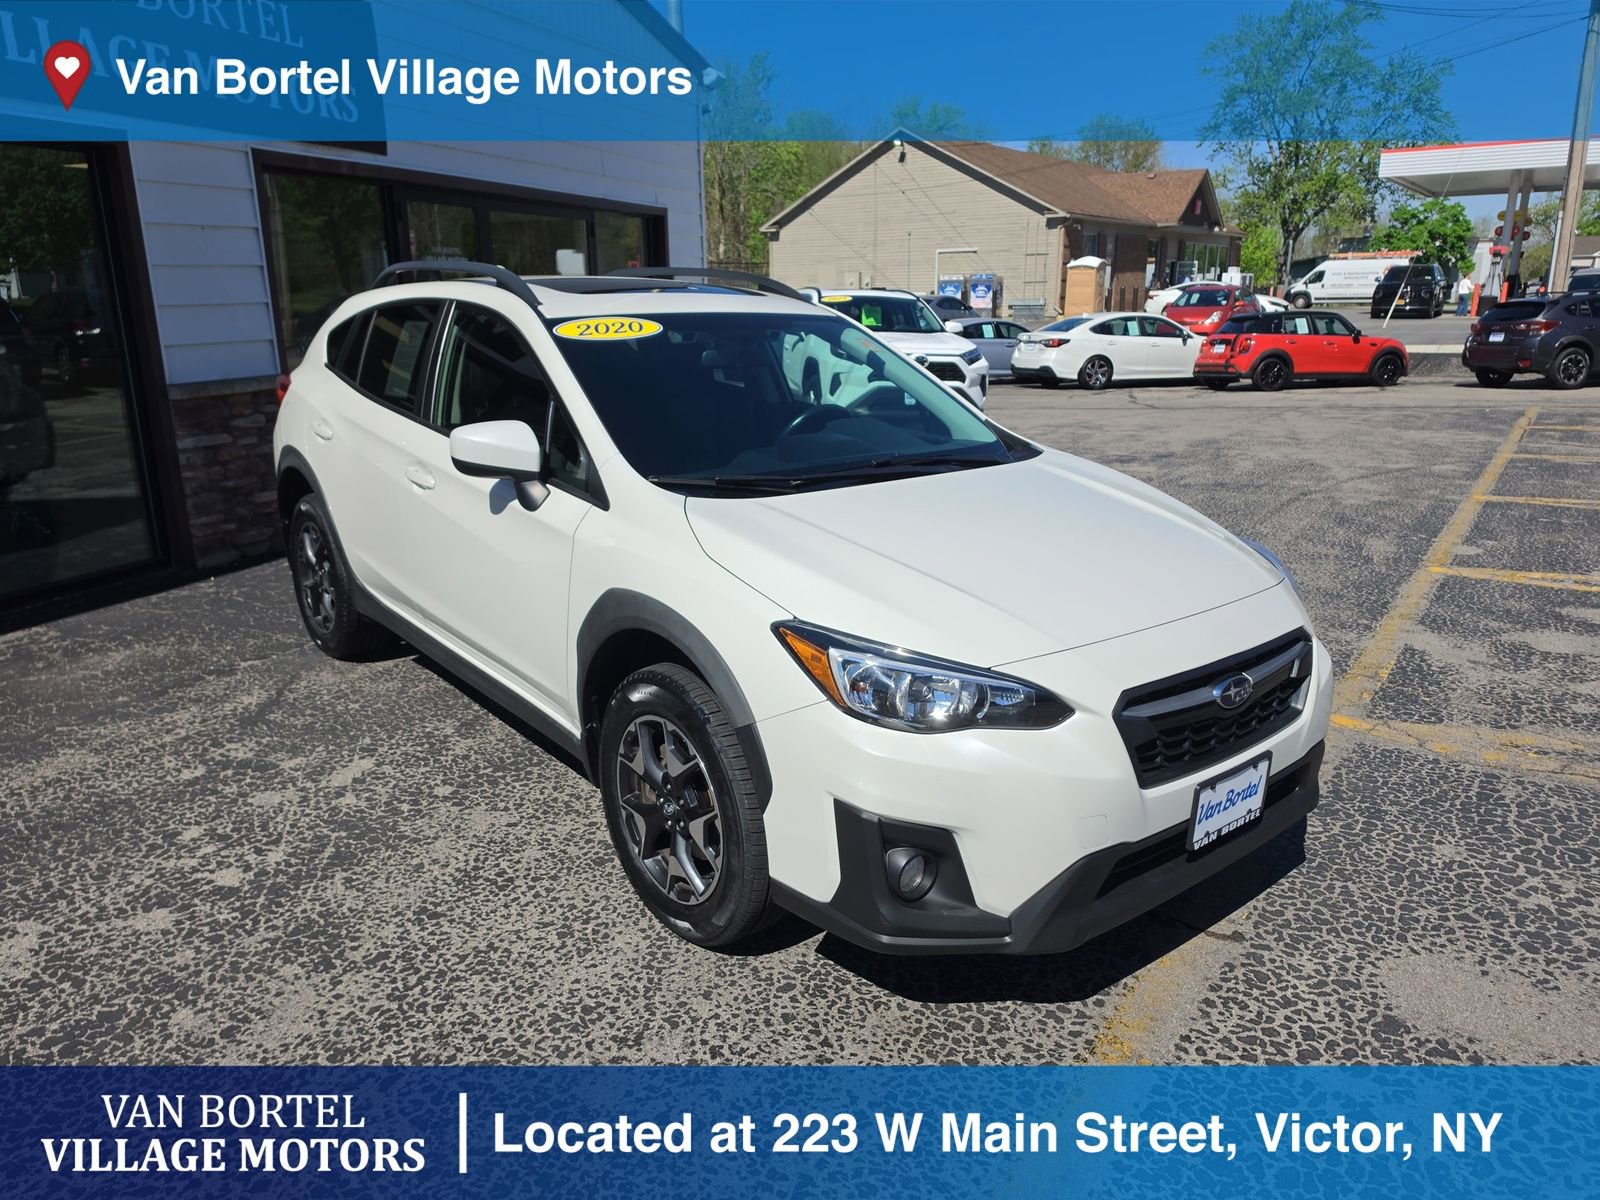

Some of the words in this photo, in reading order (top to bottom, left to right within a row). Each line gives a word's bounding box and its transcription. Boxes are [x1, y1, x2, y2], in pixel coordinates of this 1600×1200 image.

[576, 321, 644, 337] 2020
[1193, 831, 1218, 851] VAN
[1221, 808, 1261, 836] BORTEL
